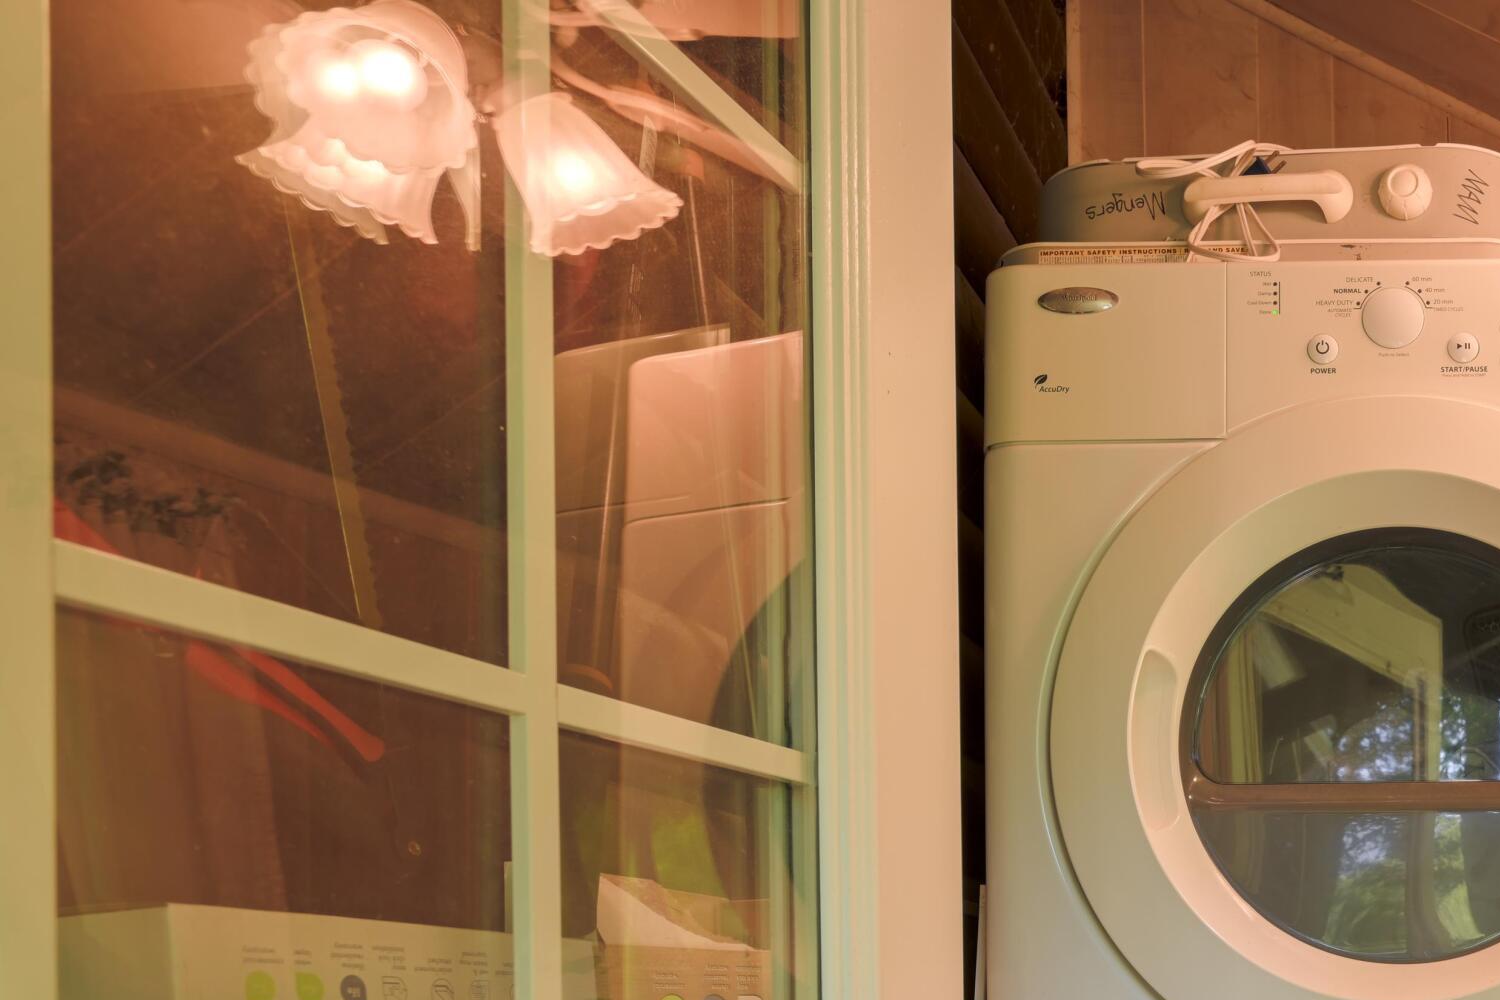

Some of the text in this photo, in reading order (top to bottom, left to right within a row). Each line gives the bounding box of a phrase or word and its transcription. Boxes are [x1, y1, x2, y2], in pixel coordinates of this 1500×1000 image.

[1086, 191, 1167, 222] Mengers
[1040, 249, 1084, 258] IMPORTANT
[1087, 249, 1116, 257] SAFETY
[1119, 248, 1177, 256] INSTRUCTIONS
[1039, 385, 1070, 394] AccuDry
